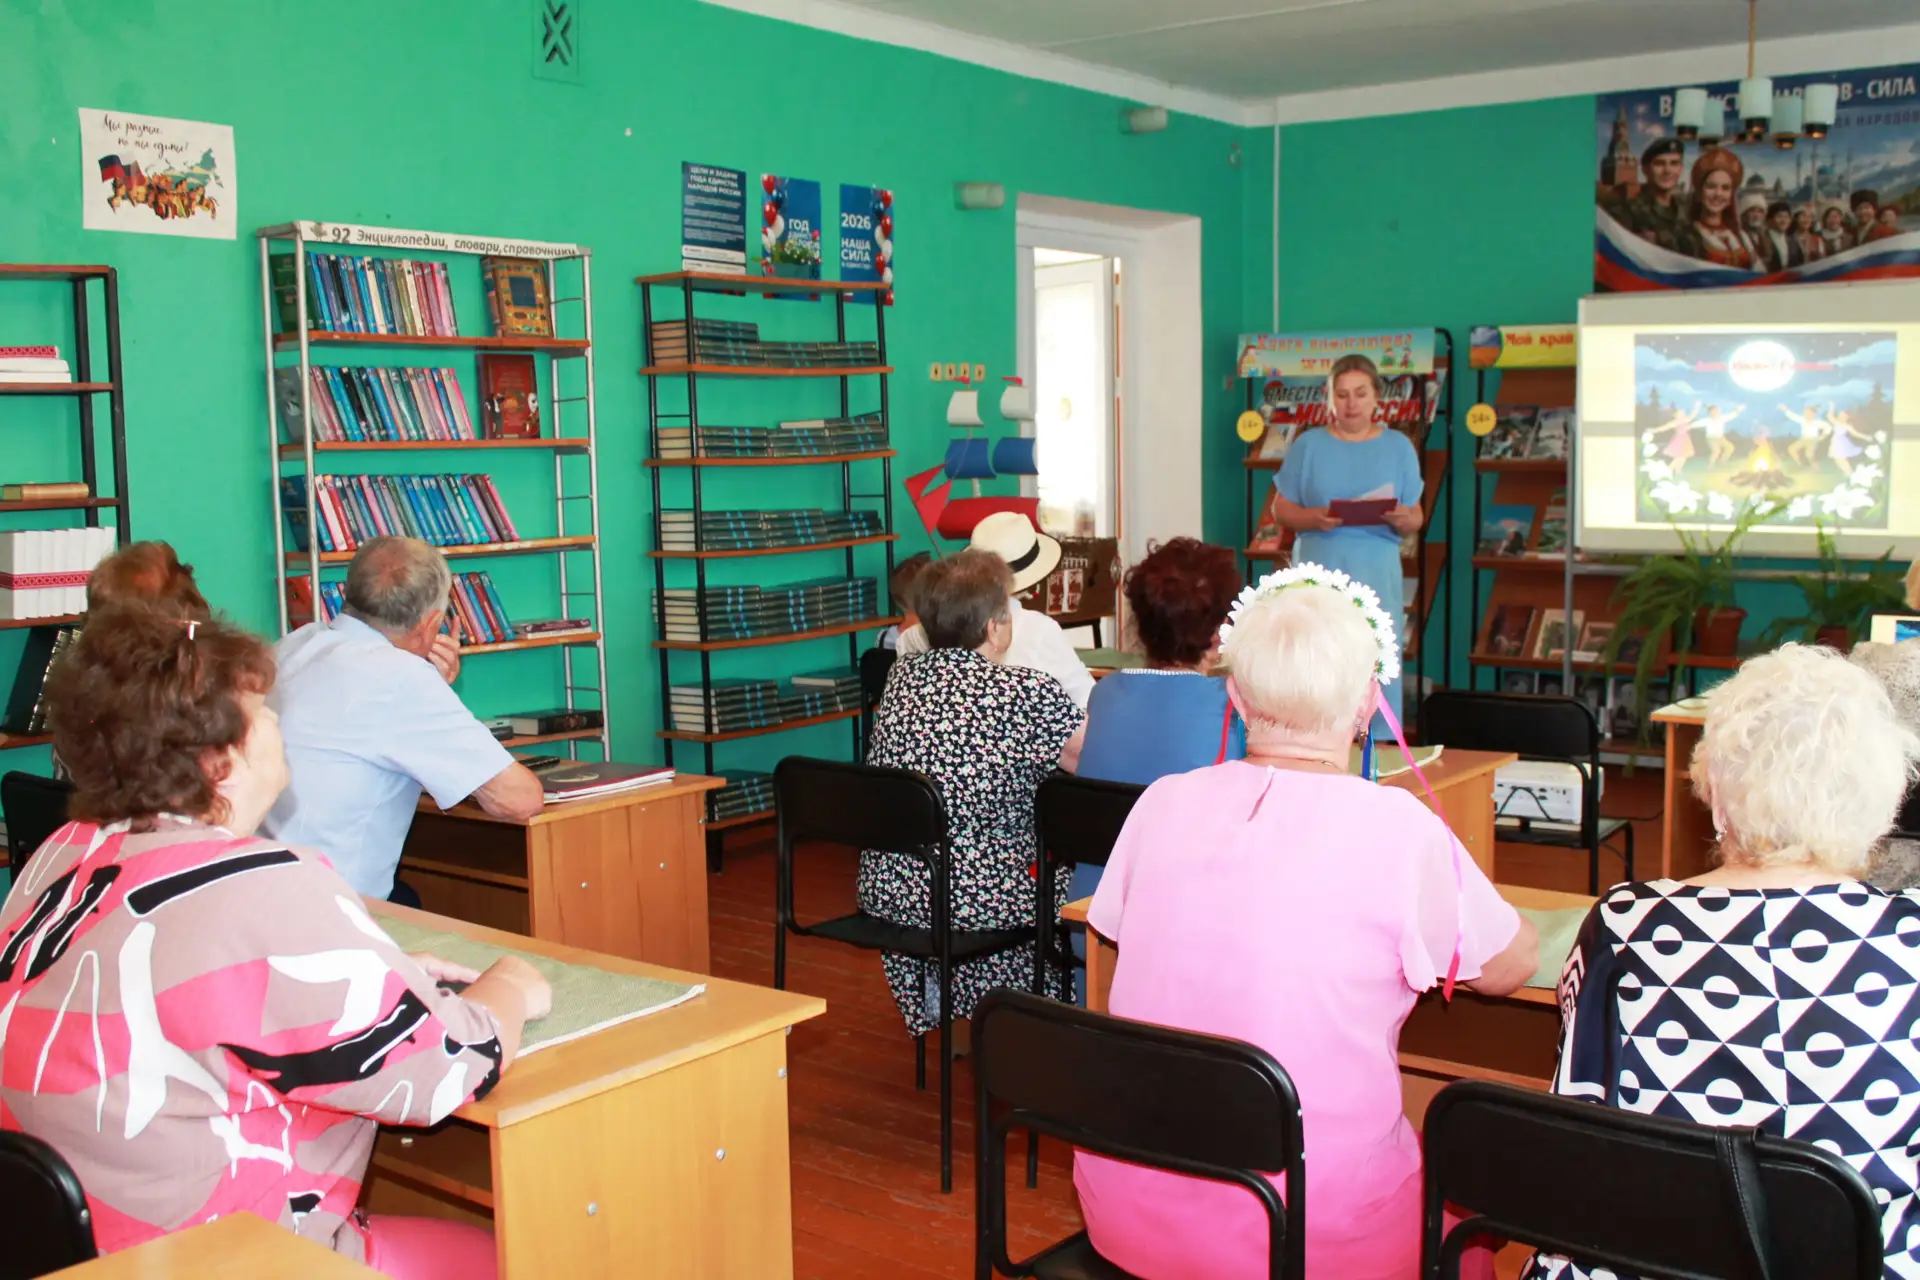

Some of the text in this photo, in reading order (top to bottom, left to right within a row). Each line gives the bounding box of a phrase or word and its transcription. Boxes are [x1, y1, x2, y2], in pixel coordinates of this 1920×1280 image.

[1660, 94, 1672, 117] В
[1867, 76, 1916, 99] СИЛА
[103, 113, 121, 132] Мы
[134, 140, 149, 150] мы
[788, 218, 809, 232] ГОД
[841, 212, 872, 230] 2026
[331, 227, 351, 244] 92
[357, 229, 448, 249] Энциклопедии,
[841, 238, 871, 250] НАША
[841, 248, 871, 262] СИЛА
[1539, 330, 1574, 349] край
